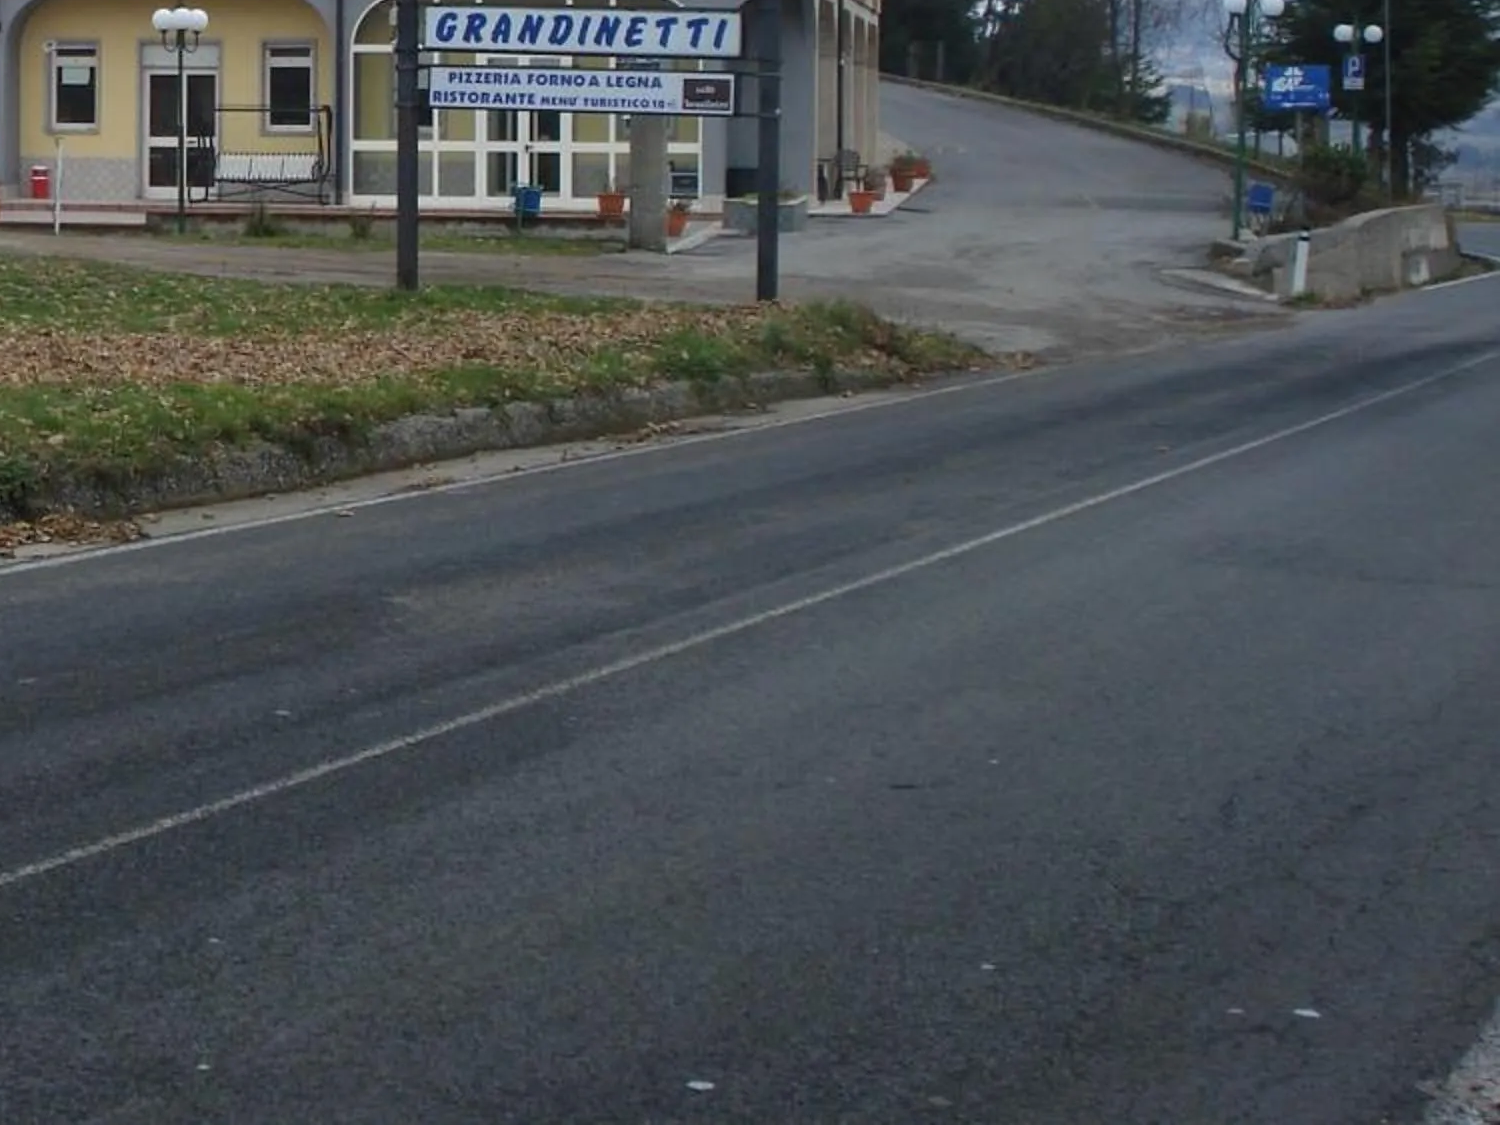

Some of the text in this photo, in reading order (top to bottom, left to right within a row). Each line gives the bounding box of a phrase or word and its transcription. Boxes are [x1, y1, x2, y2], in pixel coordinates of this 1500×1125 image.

[435, 12, 728, 49] GRANDINETTI
[1347, 56, 1360, 77] P
[448, 71, 663, 89] PIZZERIA FORNO A LEGNA
[432, 90, 536, 106] RISTORANTE
[583, 97, 650, 109] TURISTICO
